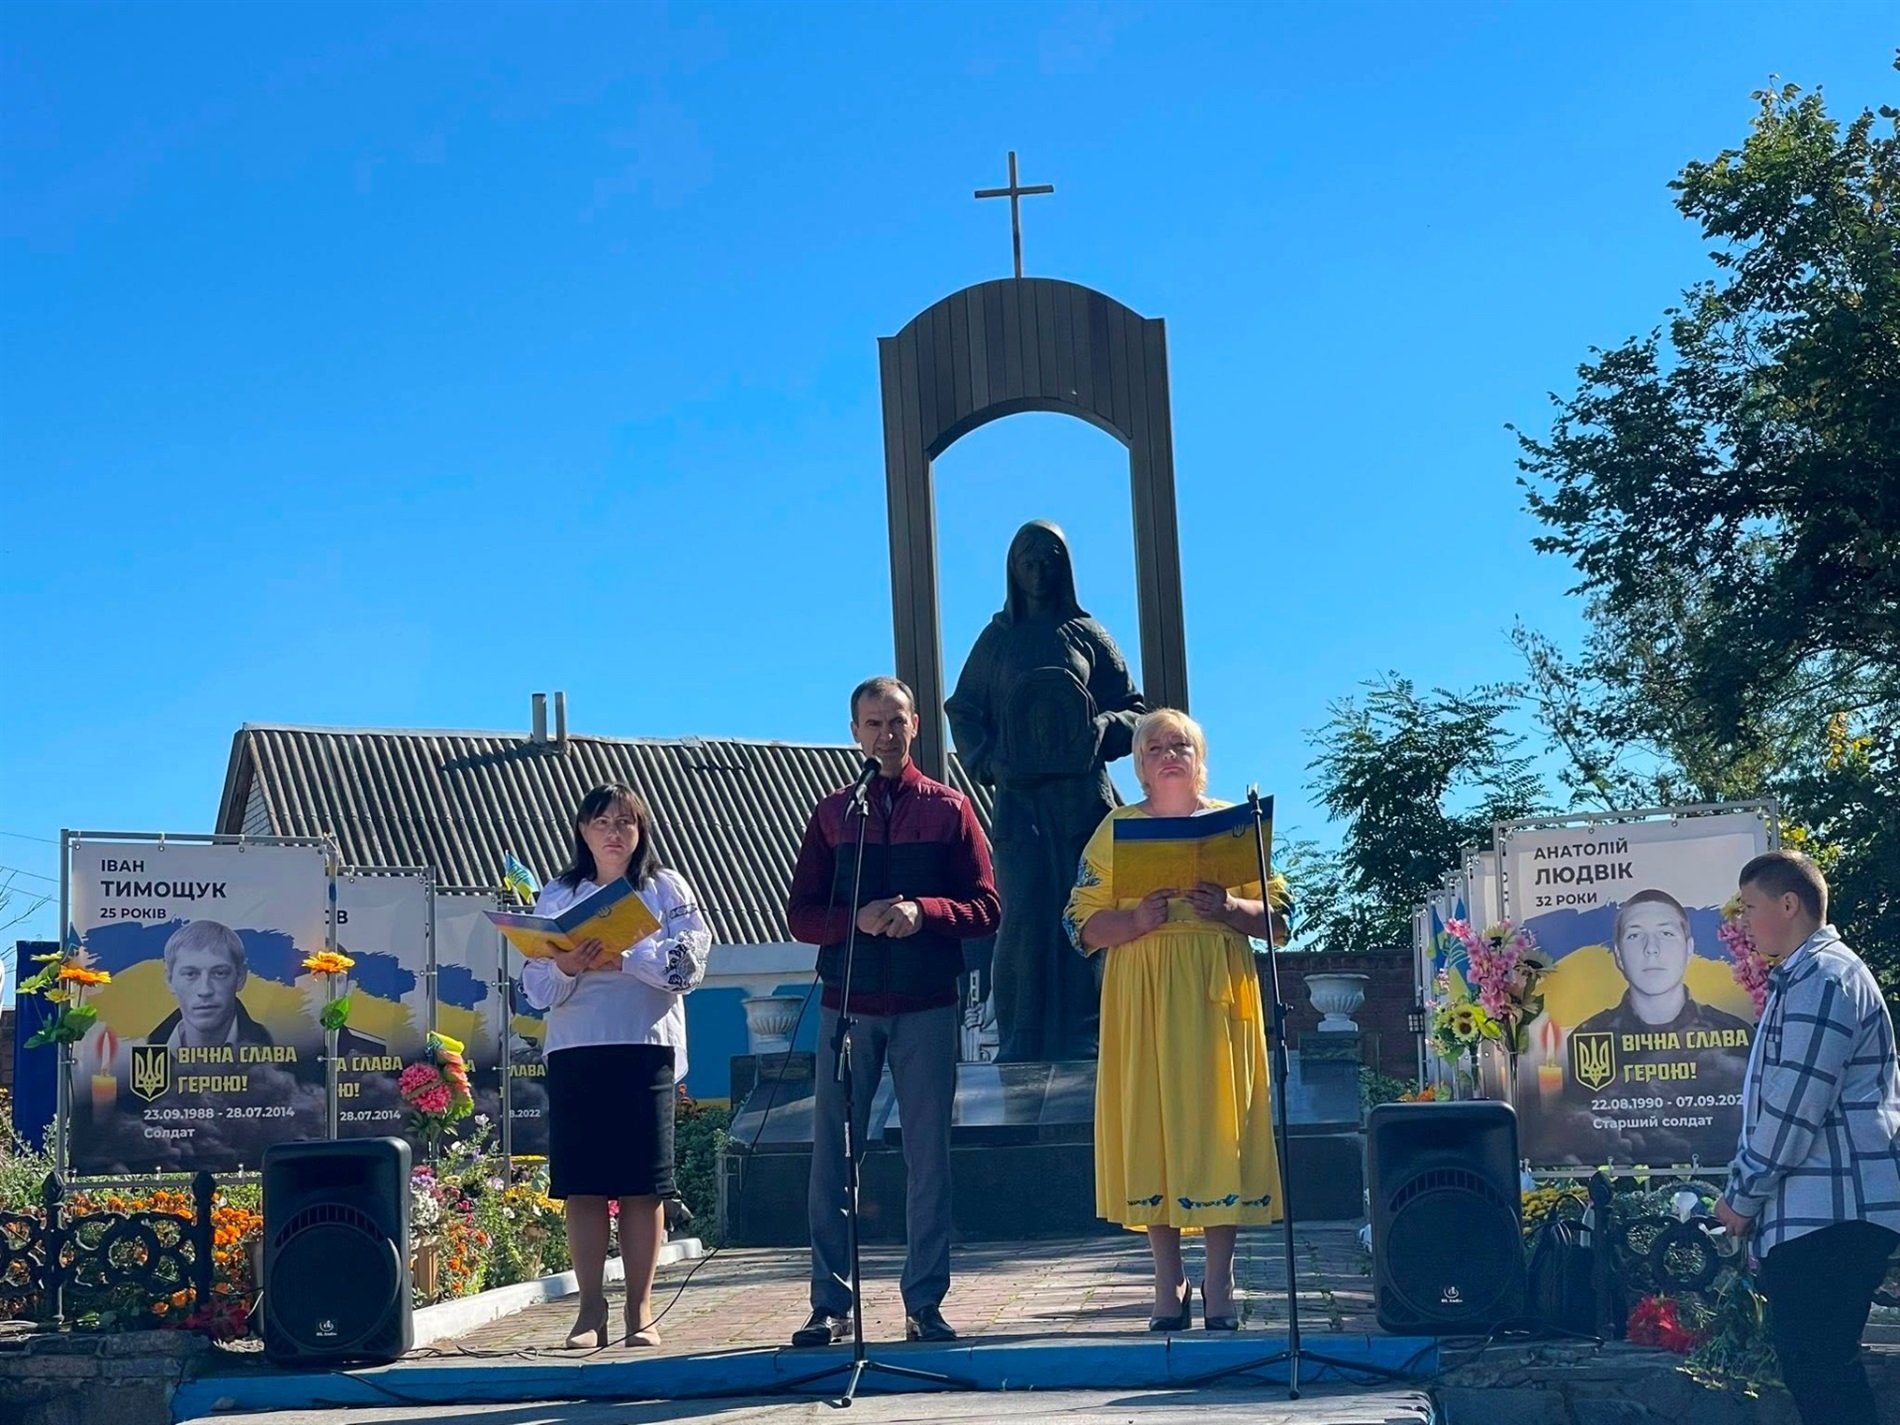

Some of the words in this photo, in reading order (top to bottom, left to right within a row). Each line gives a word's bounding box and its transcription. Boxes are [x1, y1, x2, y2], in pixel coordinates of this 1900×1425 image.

[1533, 838, 1629, 861] АНАТОЛІЙ
[101, 859, 145, 873] ІВАН
[1535, 861, 1634, 886] ЛЮДВІК
[100, 880, 227, 900] ТИМОЩУК
[1535, 895, 1552, 907] 32
[1556, 892, 1598, 905] РОКИ
[100, 907, 117, 919] 25
[121, 907, 167, 919] РОКІВ
[1622, 1031, 1681, 1051] ВІЧНА
[1686, 1029, 1749, 1049] СЛАВА
[178, 1047, 234, 1063] ВІЧНА
[240, 1046, 297, 1062] СЛАВА
[352, 1056, 403, 1071] СЛАВА
[509, 1064, 546, 1077] ЛАВА
[1623, 1062, 1697, 1083] ГЕРОЮ!
[178, 1076, 248, 1094] ГЕРОЮ!
[1591, 1096, 1664, 1111] 22.08.1990
[1676, 1094, 1744, 1108] 07.09.202
[143, 1107, 214, 1120] 23.09.1988
[226, 1106, 295, 1119] 28.07.2014
[340, 1109, 401, 1121] 28.07.2014
[1592, 1116, 1658, 1131] Старший
[1662, 1115, 1713, 1129] солдат
[144, 1127, 195, 1140] Солдат
